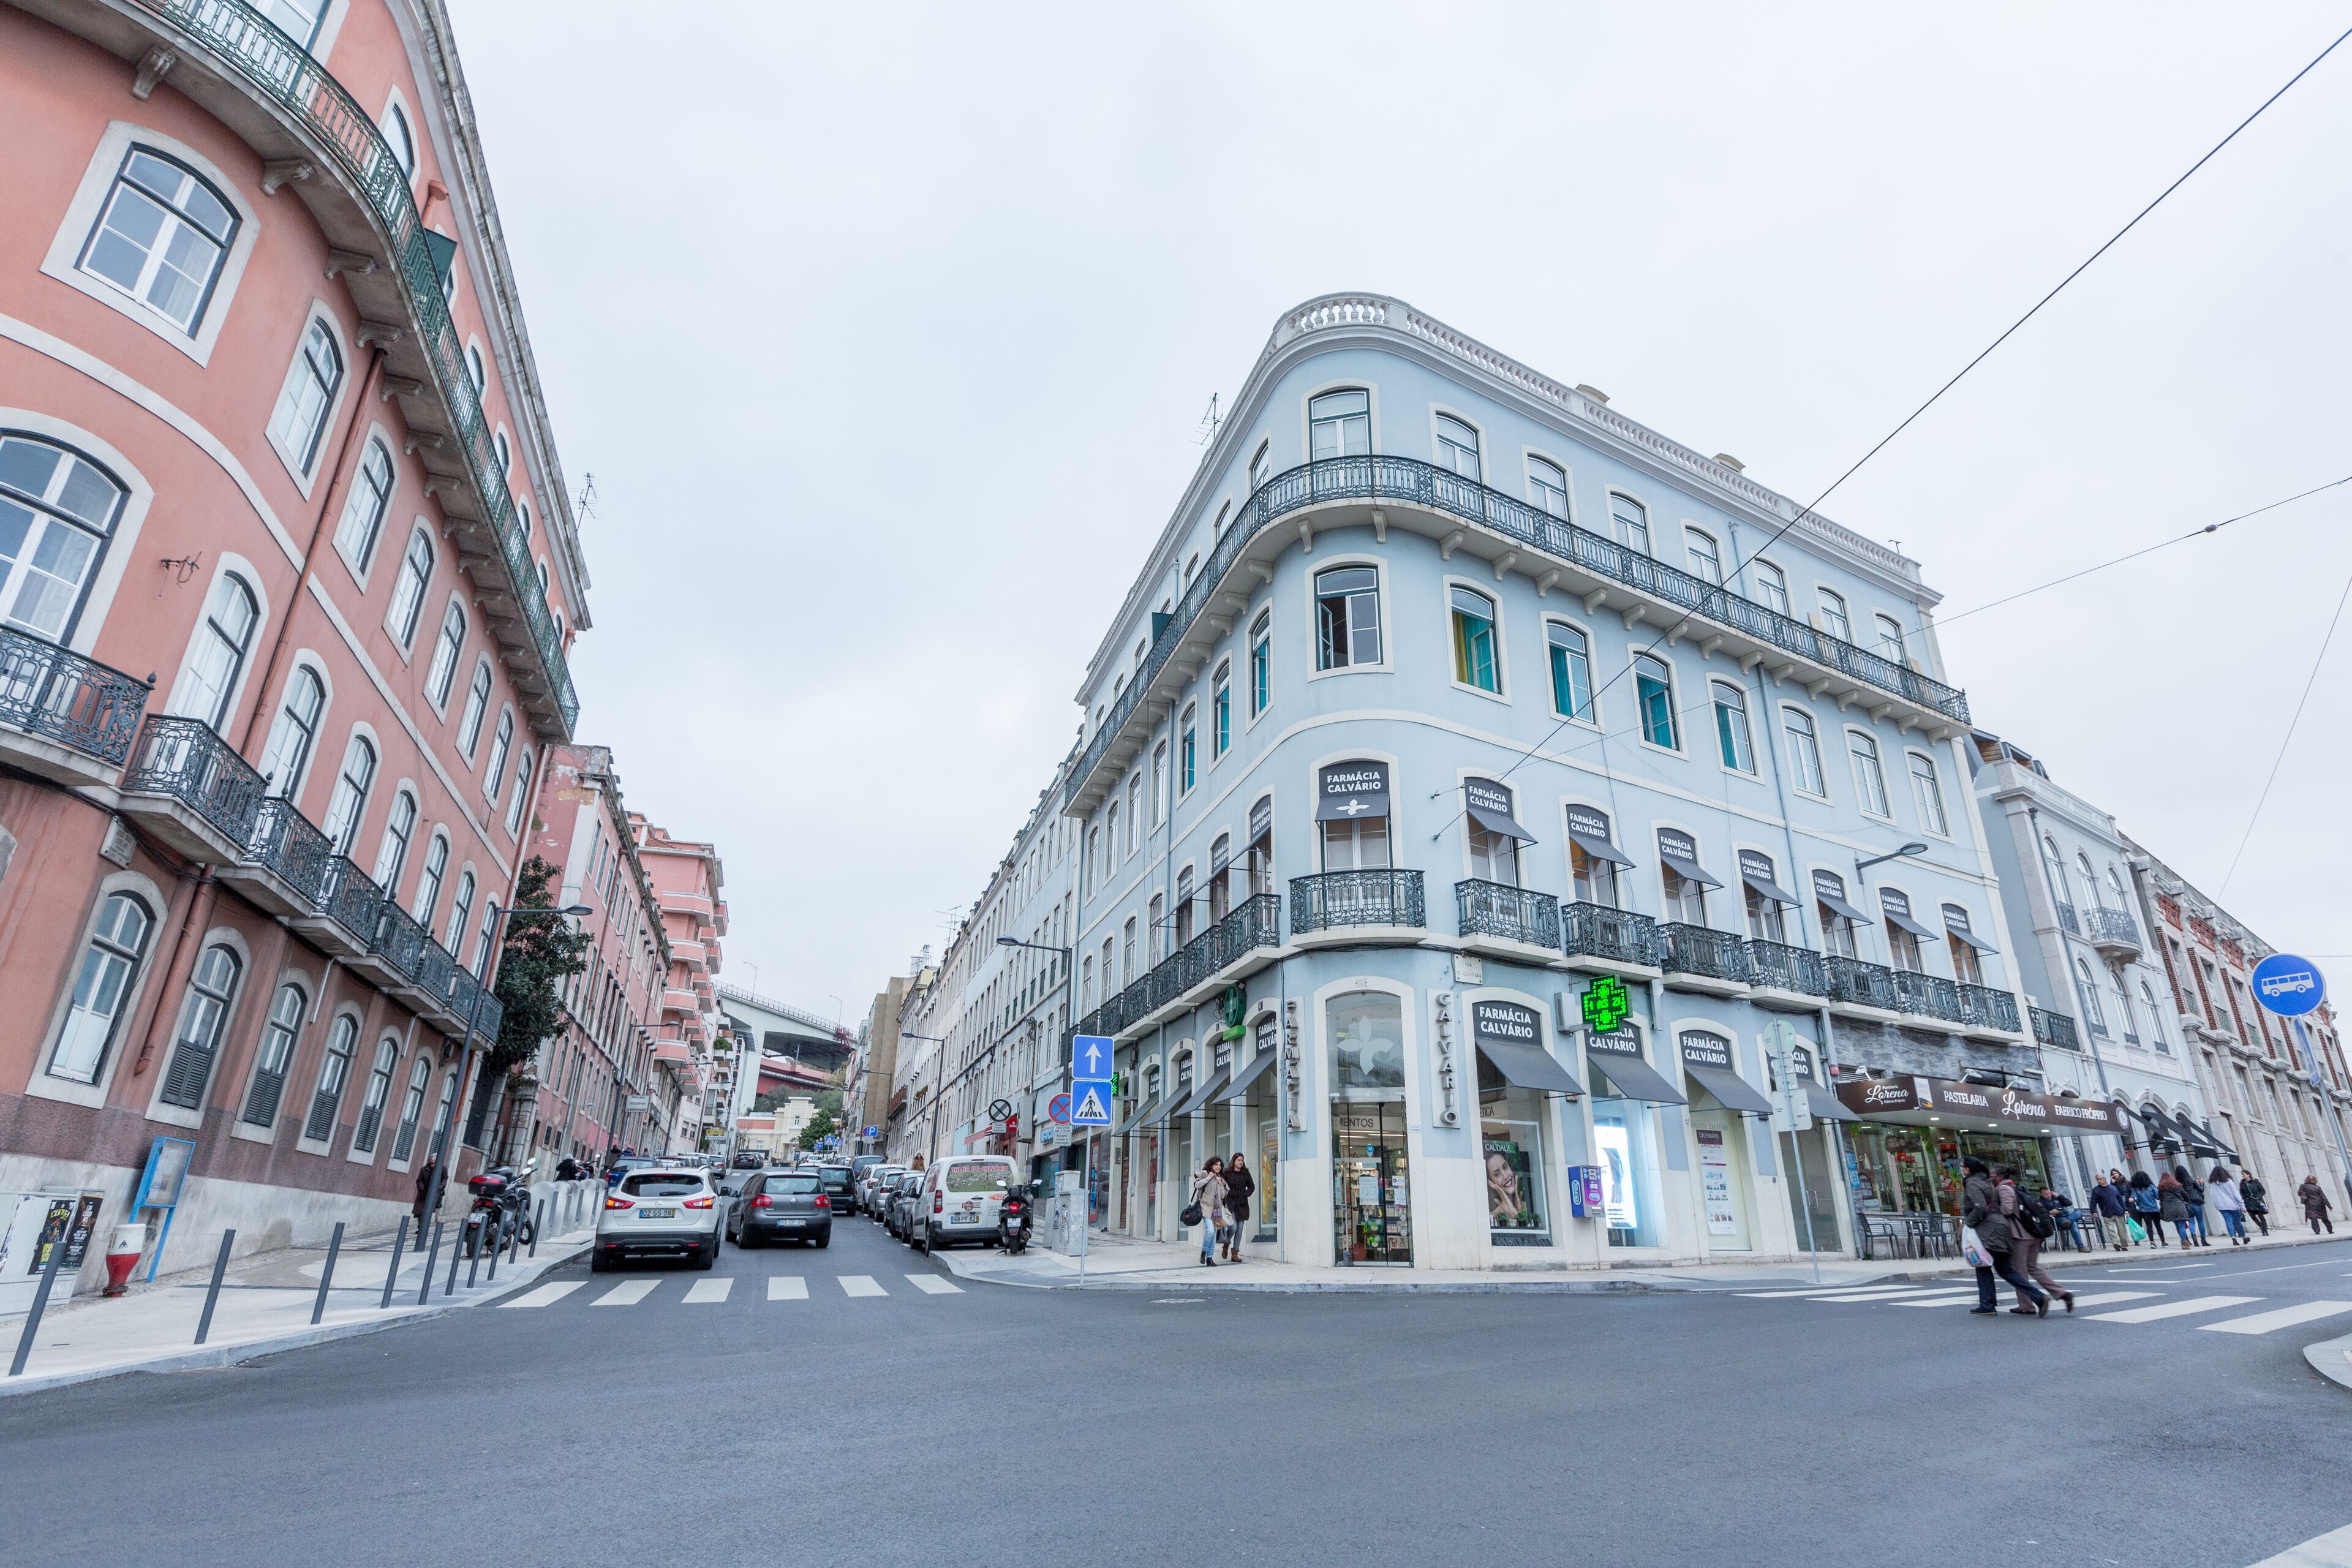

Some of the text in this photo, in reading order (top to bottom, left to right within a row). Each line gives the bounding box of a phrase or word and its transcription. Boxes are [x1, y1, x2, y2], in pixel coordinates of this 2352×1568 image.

[1327, 771, 1380, 783] FARMÁCIA
[1327, 782, 1381, 793] CALVÁRIO
[1469, 786, 1507, 803] FARMÁCIA
[1470, 796, 1508, 812] CALVÁRIO
[1252, 804, 1270, 825] FARMÁCIA
[1570, 813, 1604, 828] FARMÁCIA
[1253, 813, 1271, 834] CALVÁRIO
[1571, 822, 1605, 837] CALVÁRIO
[1660, 836, 1691, 851] FARMÁCIA
[1662, 845, 1693, 859] CALVÁRIO
[1741, 858, 1770, 871] FARMÁCIA
[1743, 867, 1771, 880] CALVÁRIO
[1815, 876, 1841, 889] FARMÁCIA
[1816, 885, 1842, 898] CALVÁRIO
[1882, 894, 1905, 906] FARMÁCIA
[1883, 903, 1907, 914] CALVÁRIO
[1944, 910, 1965, 922] FARMÁCIA
[1945, 918, 1967, 929] CALVÁRIO
[1597, 998, 1609, 1009] AS
[1479, 1006, 1531, 1023] FARMÁCIA
[1259, 1018, 1276, 1036] FARMÁC
[1480, 1021, 1533, 1038] CALVÁRIO
[1259, 1033, 1276, 1050] CALVÁR
[1589, 1037, 1636, 1052] CALVÁRIO
[1683, 1036, 1725, 1051] FARMÁCIA
[1216, 1052, 1231, 1067] CALVÁ
[1685, 1049, 1727, 1064] CALVÁRIO
[1864, 1085, 1909, 1105] Lorena
[1943, 1091, 1989, 1107] PASTELARIA
[2002, 1091, 2046, 1120] Lorena
[2054, 1105, 2082, 1118] FABRICO
[2082, 1107, 2107, 1121] PRÓPRIO
